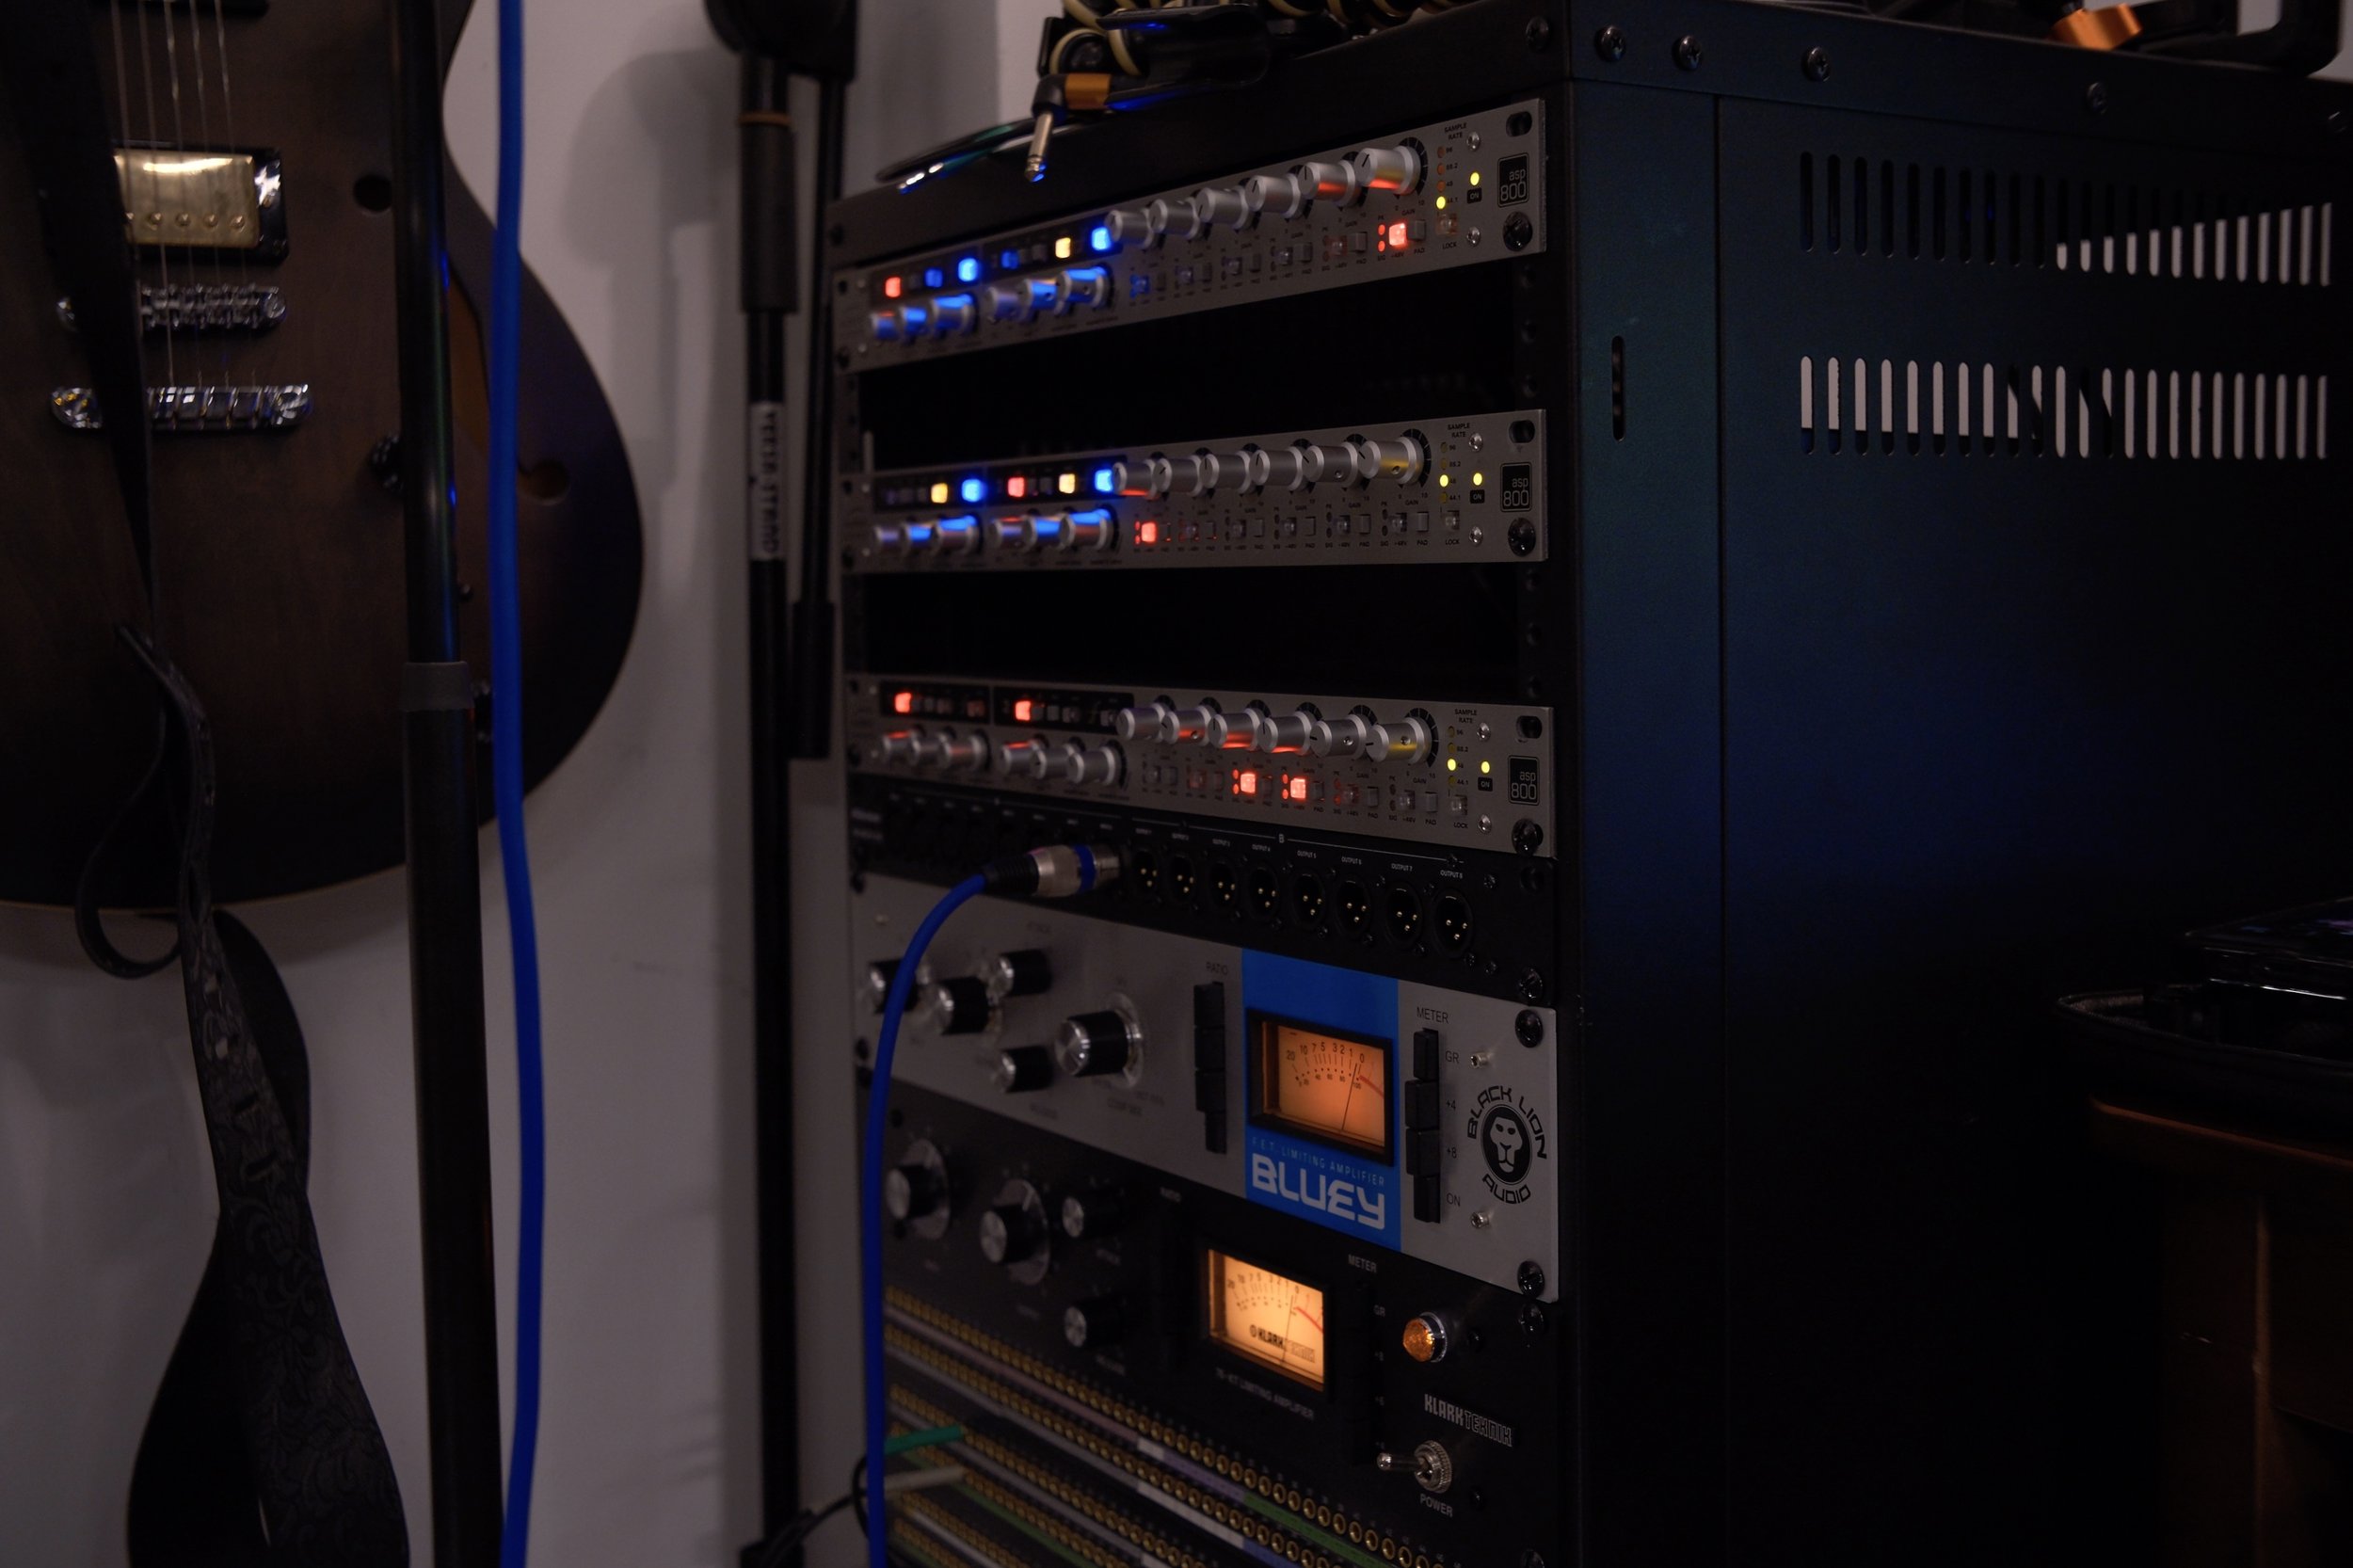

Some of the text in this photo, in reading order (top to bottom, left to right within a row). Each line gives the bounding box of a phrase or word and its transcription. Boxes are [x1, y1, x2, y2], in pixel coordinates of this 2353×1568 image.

[1444, 122, 1467, 133] SAMPLE
[1448, 132, 1463, 140] RATE
[1509, 168, 1527, 184] asp
[1500, 182, 1527, 202] 800
[1448, 423, 1470, 431] SAMPLE
[1512, 478, 1529, 490] asp
[1504, 490, 1529, 507] 800
[1454, 708, 1477, 716] SAMPLE
[1520, 772, 1536, 784] asp
[1512, 782, 1537, 800] 800
[1391, 862, 1408, 871] OUTPUT
[1440, 869, 1458, 878] OUTPUT
[1417, 1007, 1449, 1024] METER
[1300, 1045, 1308, 1055] 10
[1321, 1041, 1325, 1051] 5
[1333, 1043, 1337, 1052] 3
[1340, 1044, 1345, 1054] 2
[1359, 1053, 1365, 1064] 0
[1446, 1050, 1459, 1064] GR
[1446, 1099, 1456, 1111] +4
[1467, 1085, 1547, 1159] BLACK LION
[1447, 1147, 1457, 1159] +8
[1281, 1147, 1325, 1169] LIMITING
[1330, 1160, 1385, 1187] AMPLIFIER
[1252, 1152, 1385, 1230] BLUEY
[1481, 1173, 1531, 1204] AUDIO
[1446, 1192, 1461, 1207] ON
[1348, 1254, 1378, 1272] METER
[1373, 1304, 1385, 1317] GR
[1273, 1394, 1315, 1422] AMPLIFIER
[1419, 1493, 1453, 1517] POWER
